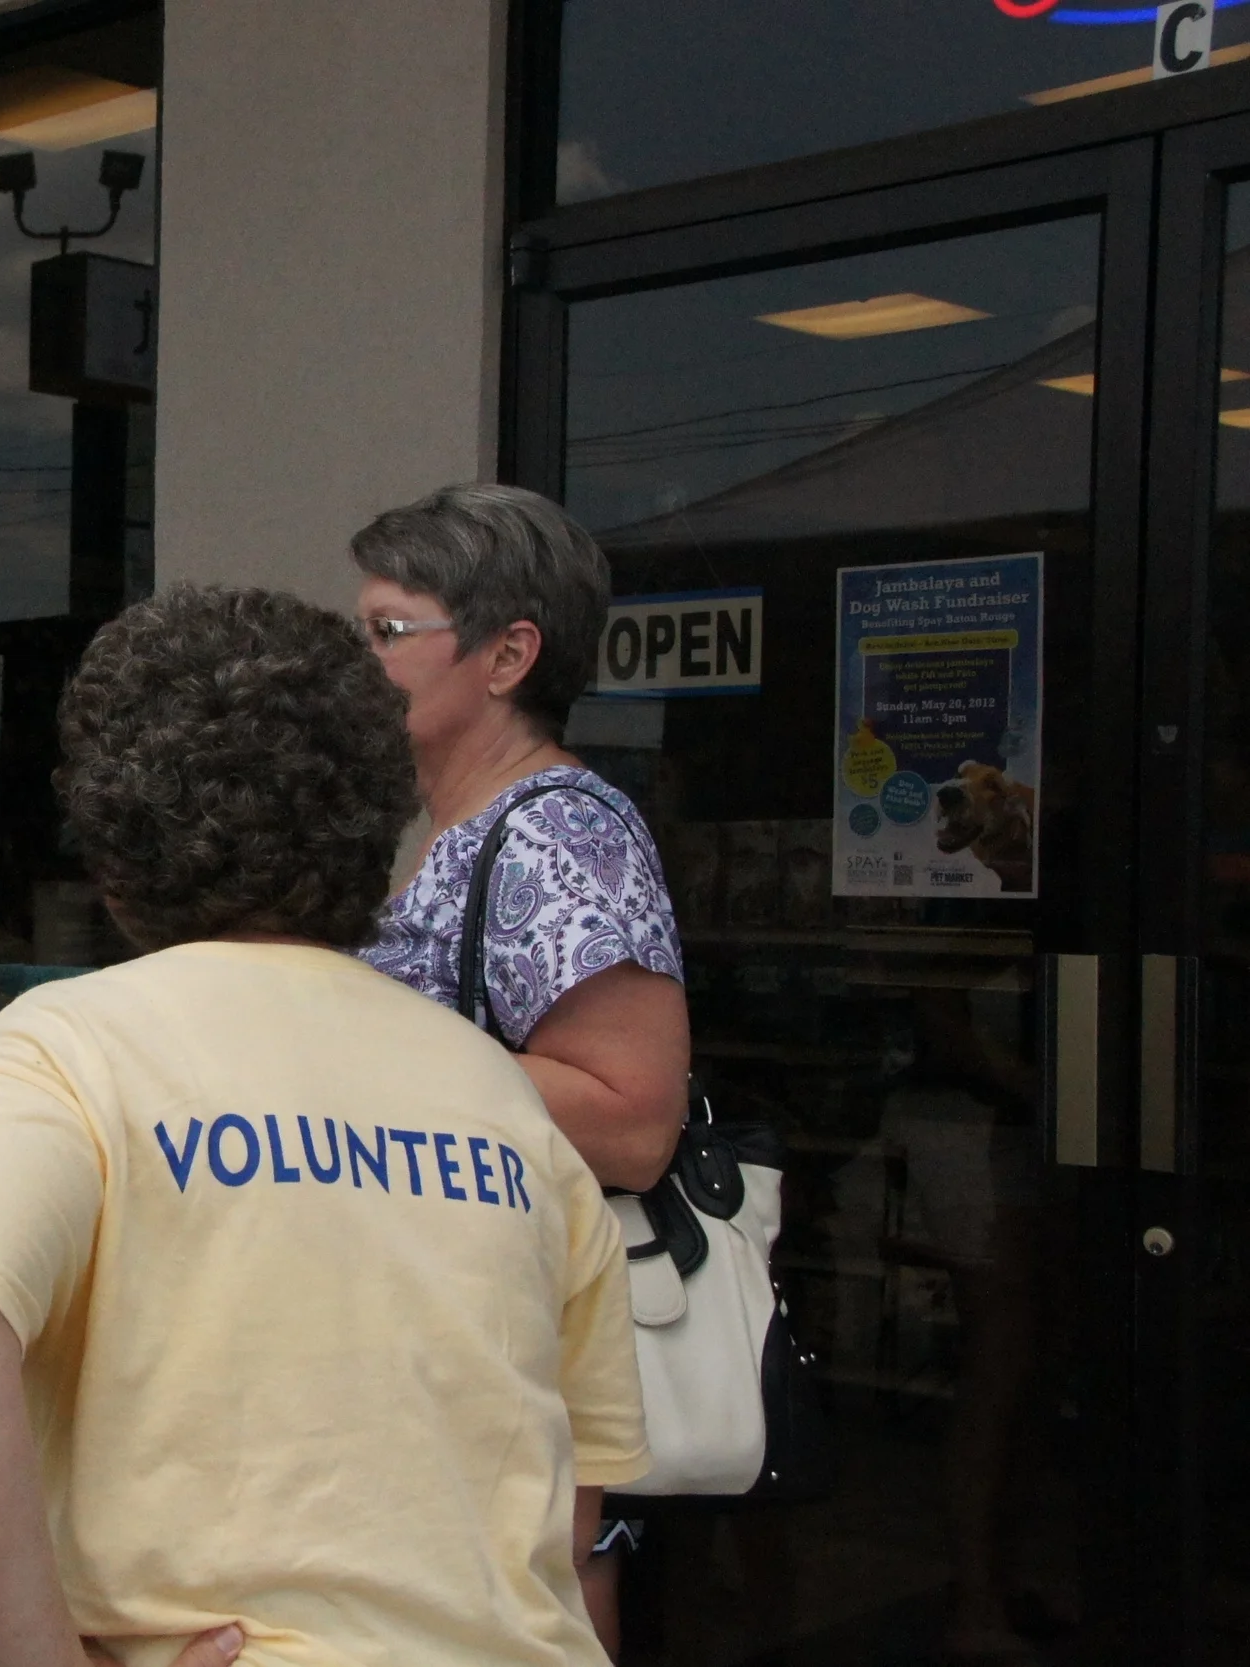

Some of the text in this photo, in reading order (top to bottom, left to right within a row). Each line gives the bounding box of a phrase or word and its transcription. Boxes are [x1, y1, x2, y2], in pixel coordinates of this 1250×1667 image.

[1161, 2, 1207, 72] C
[874, 572, 1000, 597] Jambalaya and
[849, 592, 1030, 616] Dog Wash Fundraiser
[861, 612, 1016, 629] Benefiting Spay Baton Rouge
[607, 608, 752, 681] OPEN
[876, 697, 995, 712] Sunday, May 20, 2012
[902, 714, 933, 724] 11am
[941, 713, 967, 725] 3pm
[945, 872, 974, 883] MARKET
[154, 1113, 531, 1214] VOLUNTEER
